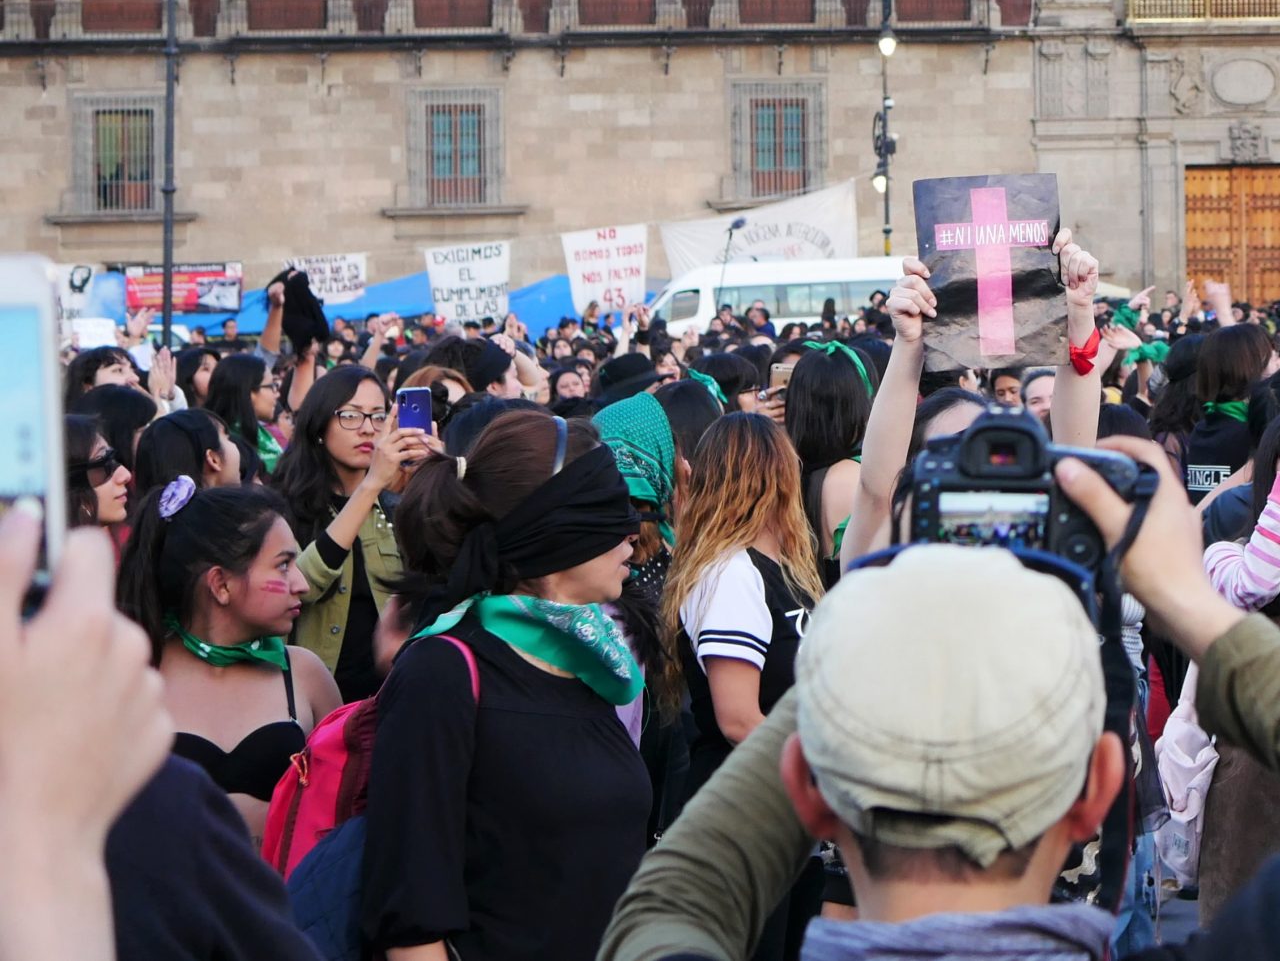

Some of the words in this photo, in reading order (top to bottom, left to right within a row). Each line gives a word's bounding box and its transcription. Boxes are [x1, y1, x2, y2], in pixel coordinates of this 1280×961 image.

[596, 228, 617, 241] NO
[975, 223, 1006, 245] UNA
[1009, 222, 1047, 244] MENOS
[432, 244, 503, 265] EXIGIMOS
[458, 267, 476, 282] EL
[603, 287, 626, 309] 43
[455, 303, 468, 317] DE
[475, 299, 499, 316] LAS
